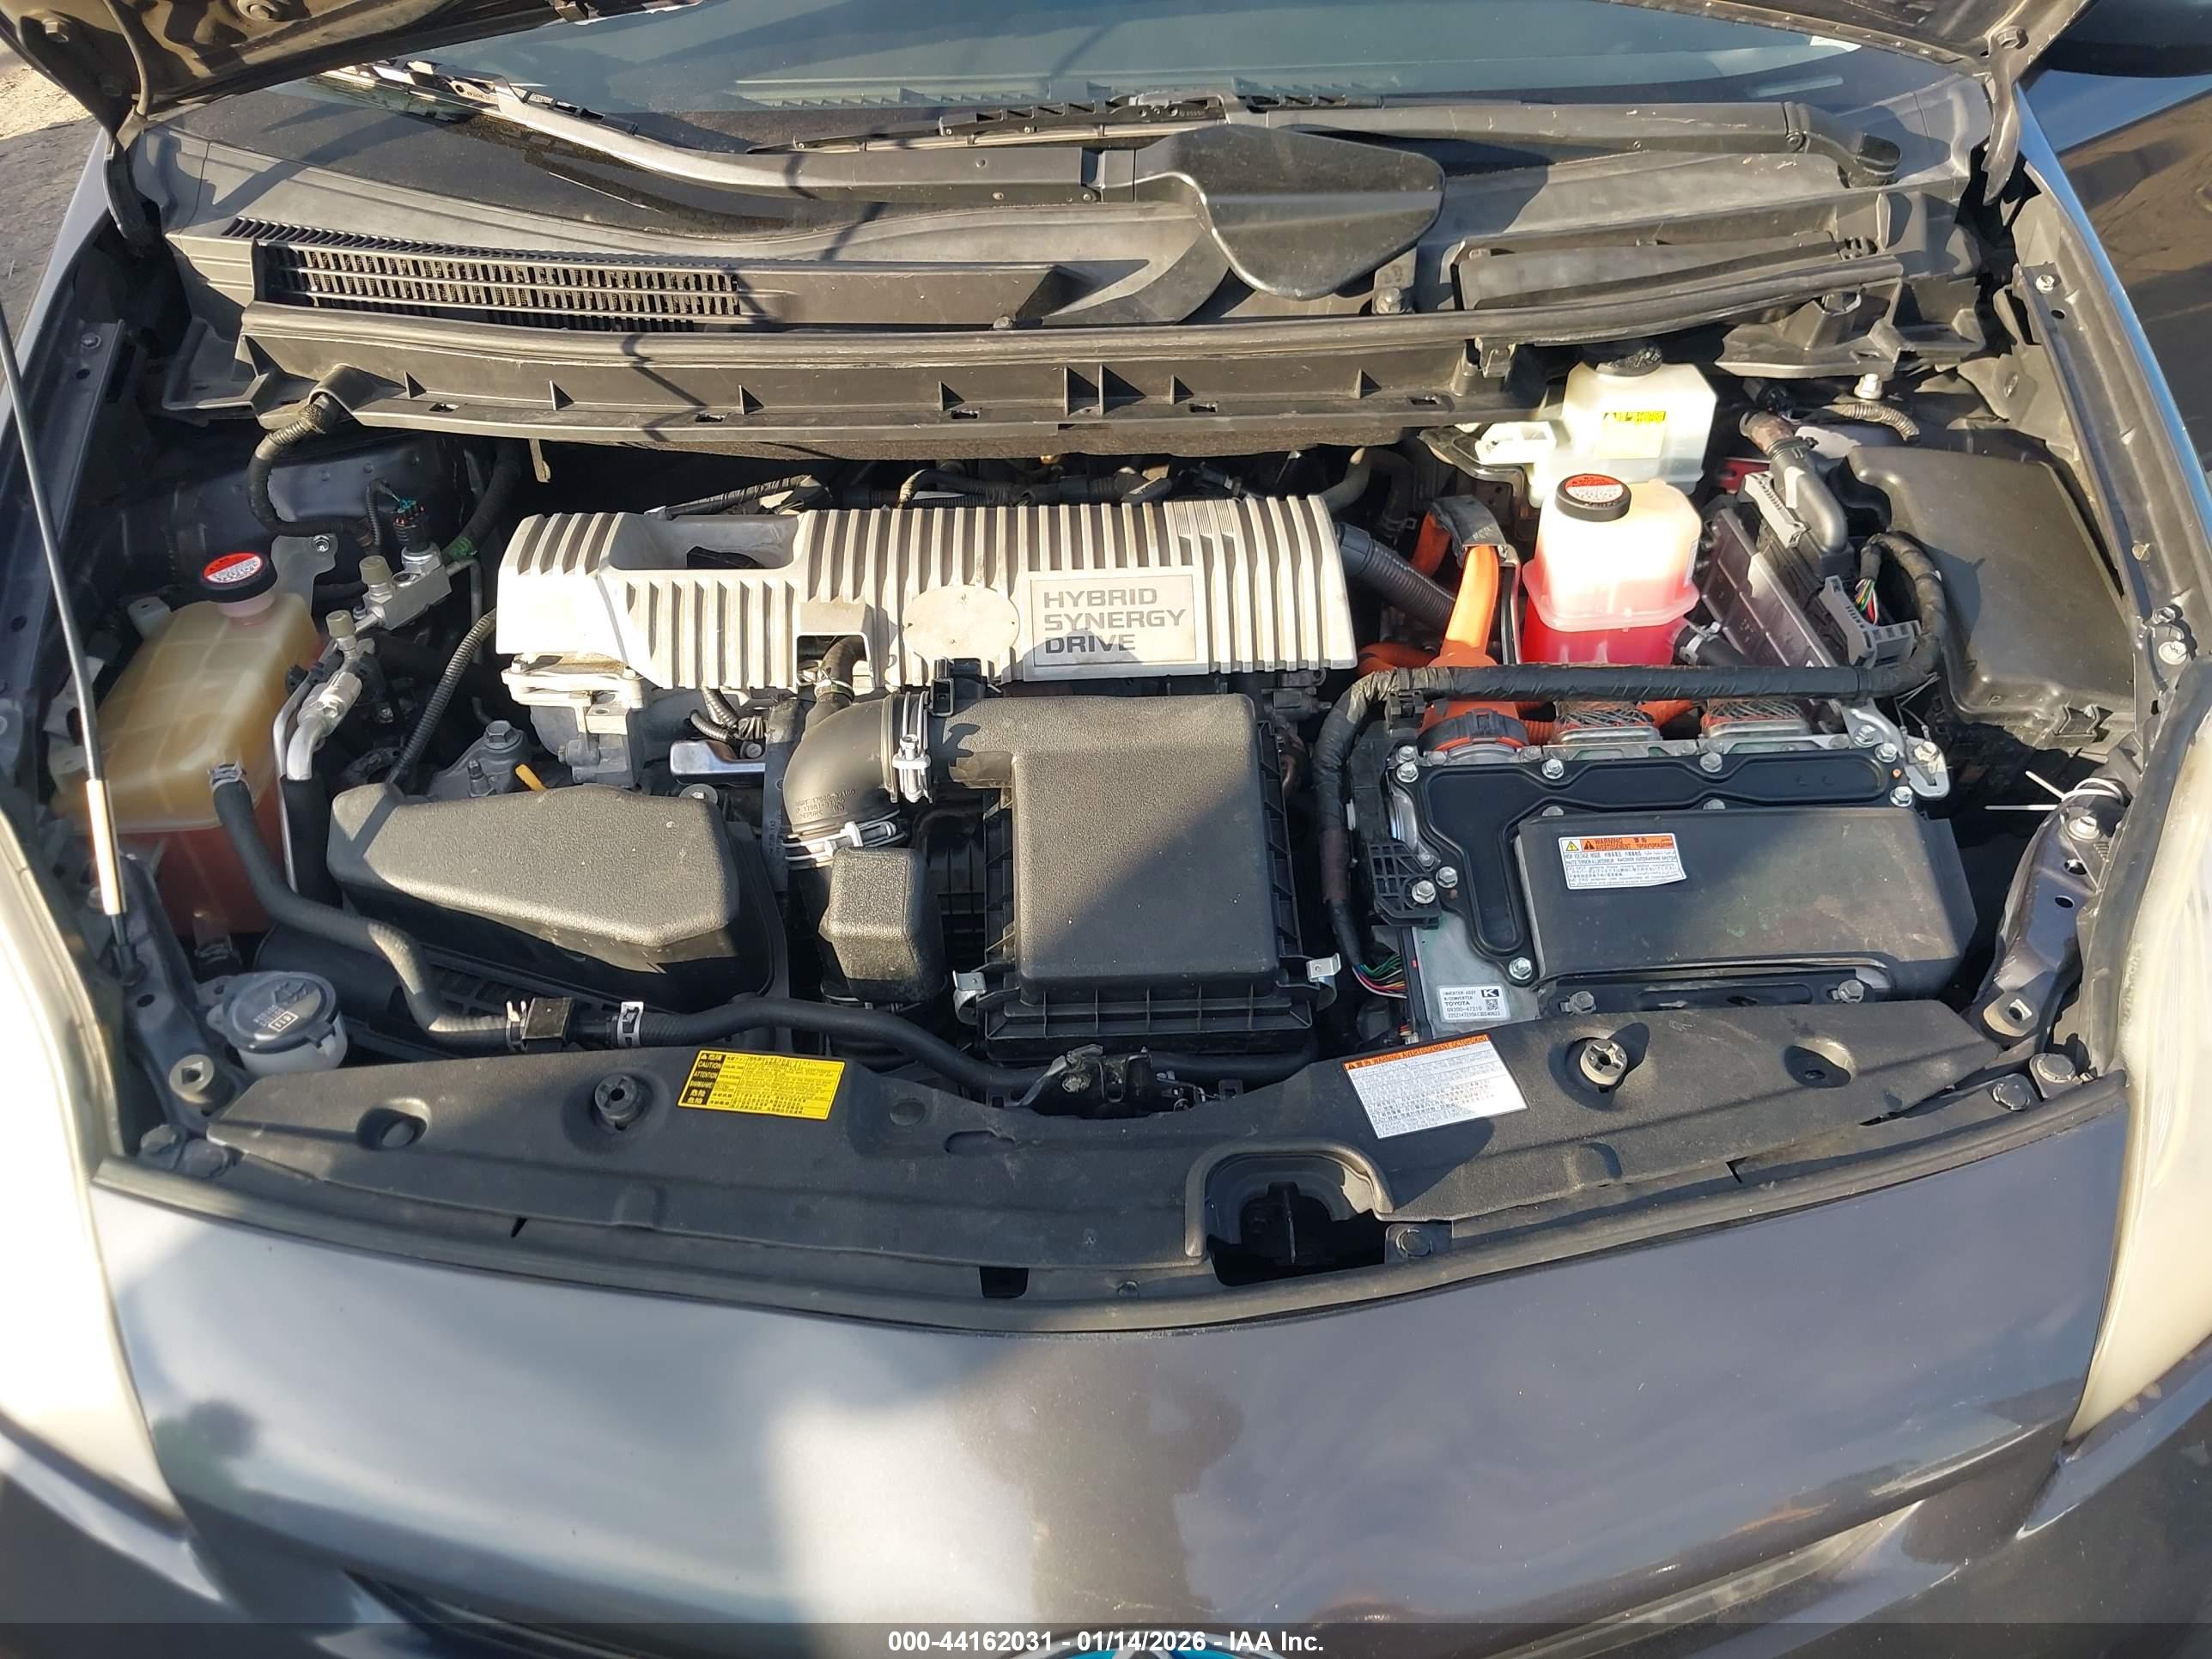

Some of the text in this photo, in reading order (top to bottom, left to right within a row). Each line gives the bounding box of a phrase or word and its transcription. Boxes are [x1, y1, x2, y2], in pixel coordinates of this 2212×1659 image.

[1043, 587, 1158, 608] HYBRID
[1044, 608, 1187, 631] SYNERGY
[1045, 634, 1136, 654] DRIVE
